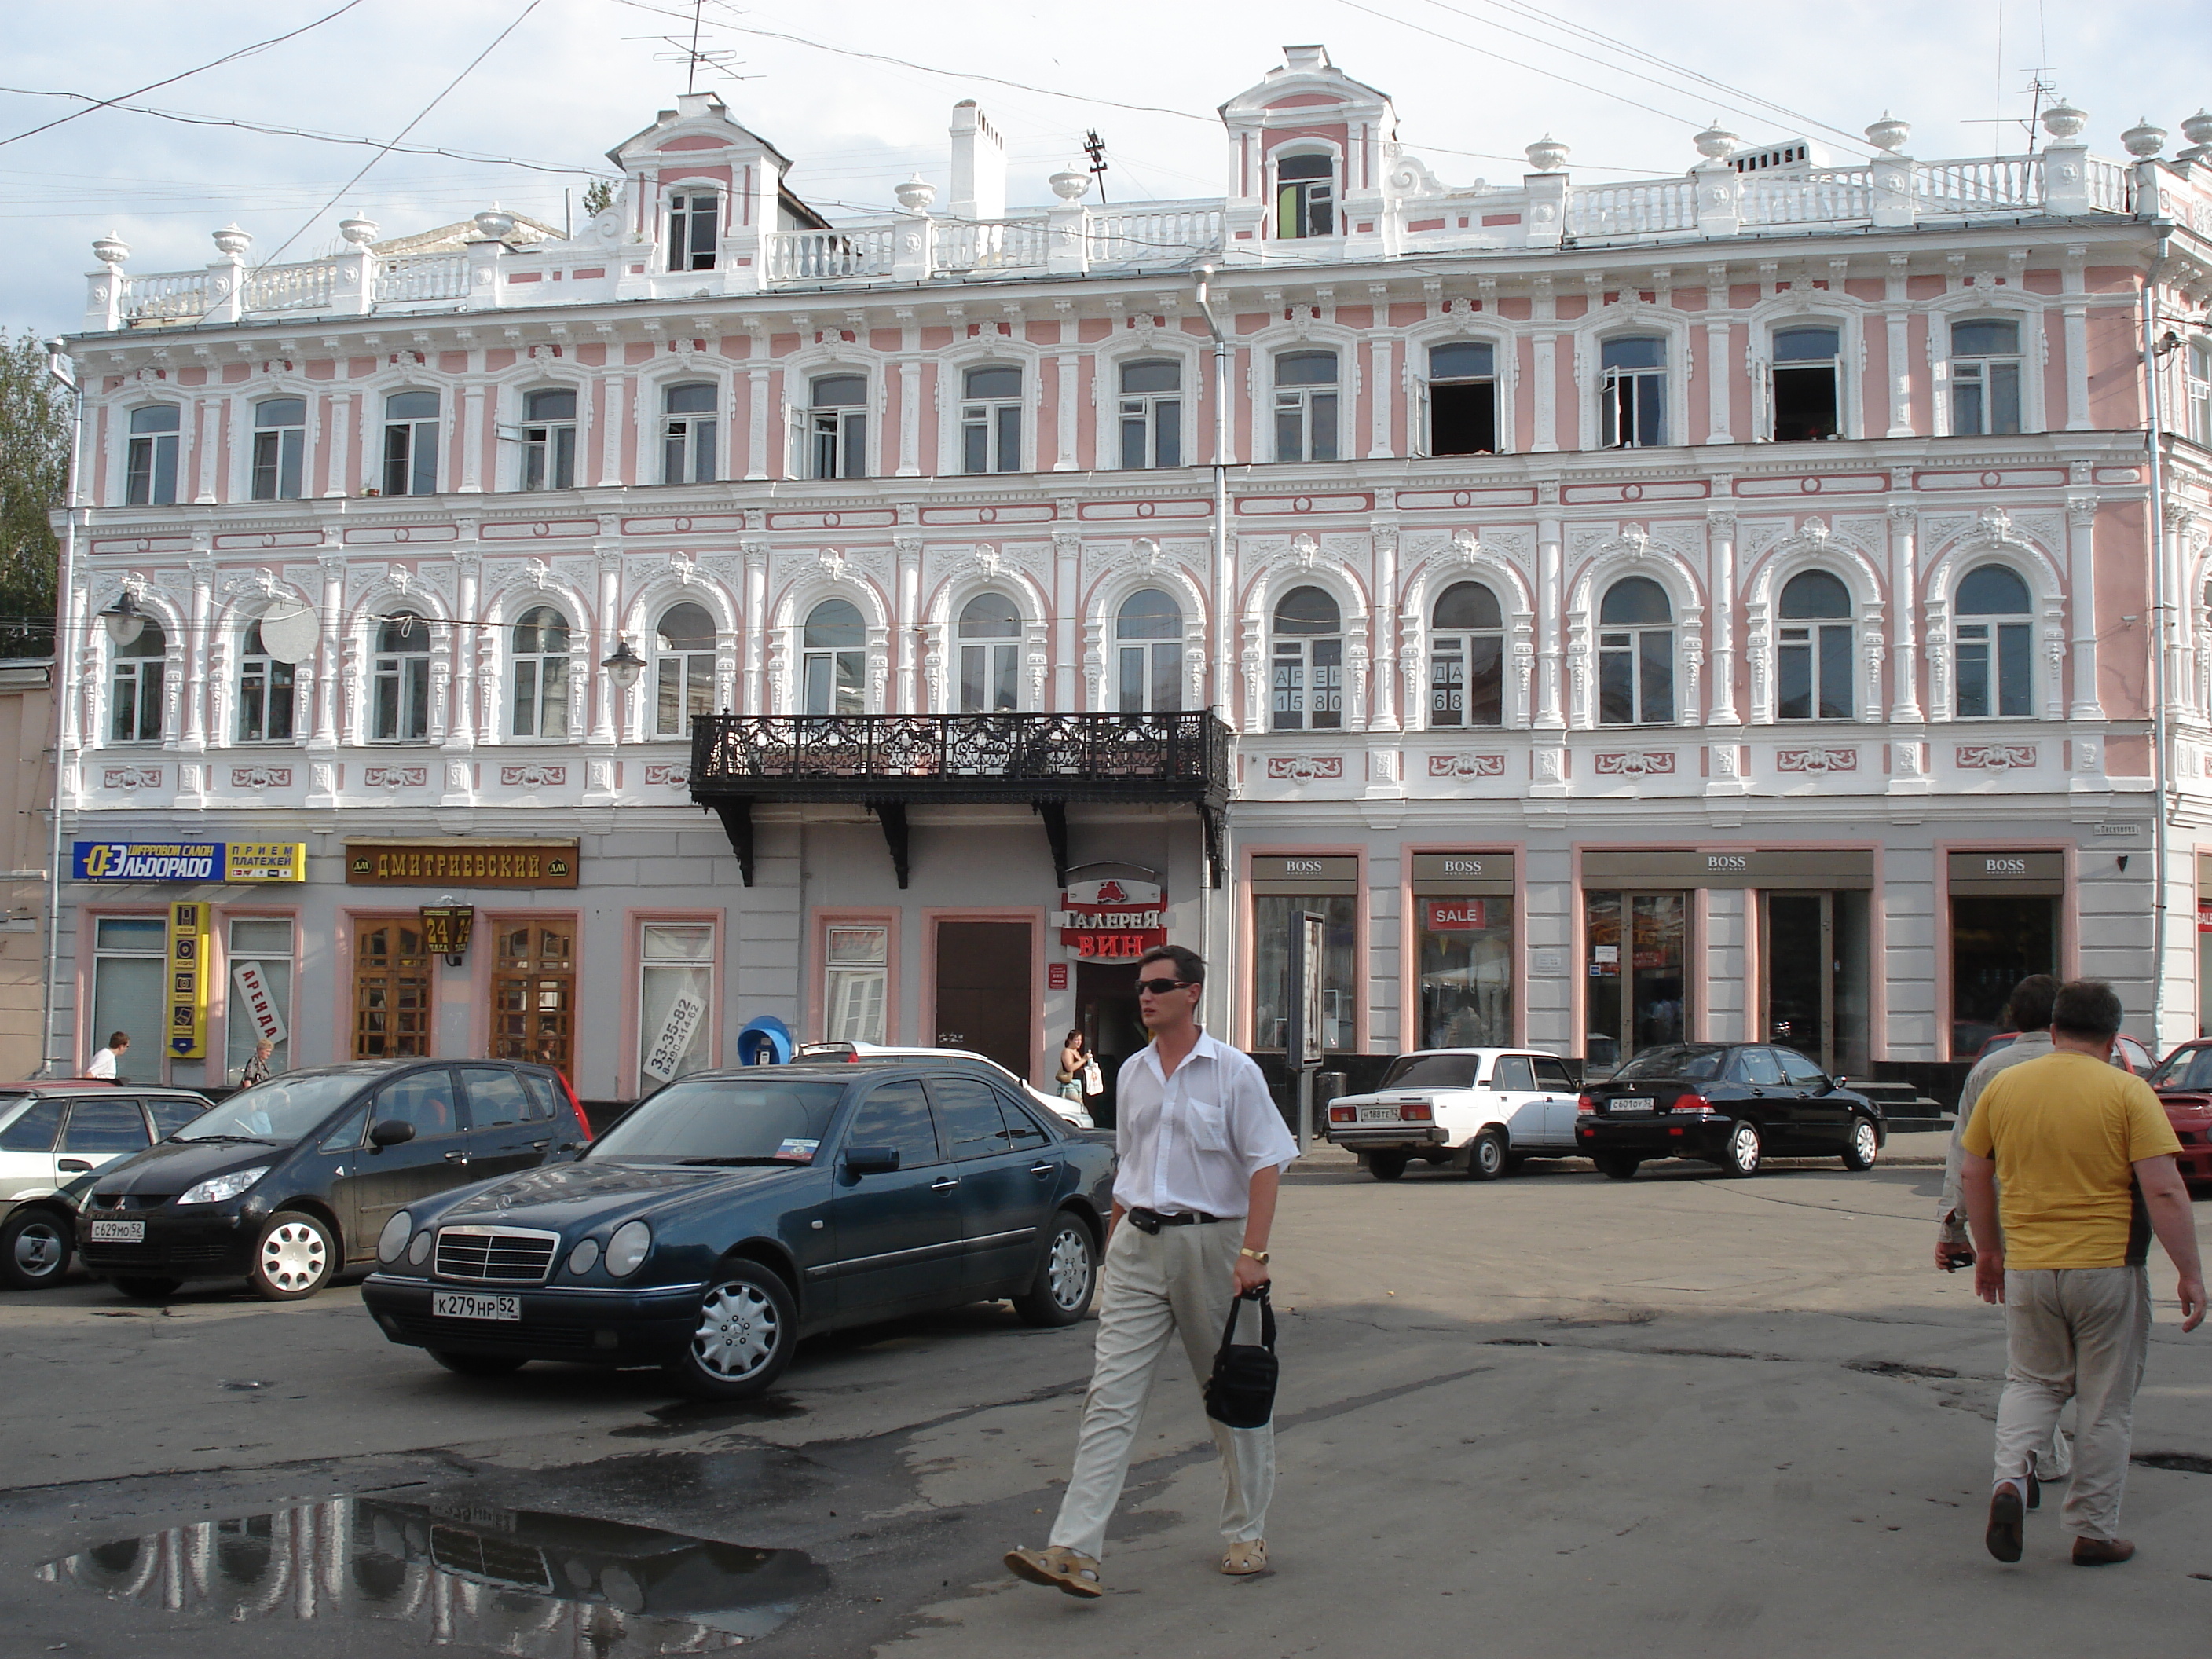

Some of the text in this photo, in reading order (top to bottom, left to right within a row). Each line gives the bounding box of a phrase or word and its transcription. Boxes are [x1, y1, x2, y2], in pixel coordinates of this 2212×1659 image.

[181, 844, 214, 857] САЛОН
[232, 845, 293, 855] ПРИЕМ
[232, 855, 292, 866] ПЛАТЕЖЕЙ
[378, 853, 540, 879] ДМИТРИЕВСКИЙ
[1286, 860, 1322, 872] BOSS
[1445, 860, 1481, 872] BOSS
[1708, 855, 1746, 868] BOSS
[1986, 859, 2025, 871] BOSS
[1063, 909, 1160, 930] ГАЛЕРЕЯ
[1436, 909, 1477, 923] SALE
[426, 917, 449, 943] 24
[1077, 935, 1144, 958] ВИН
[242, 969, 278, 1038] АРЕНДА
[650, 998, 691, 1071] 33-35-82
[661, 1004, 699, 1075] 8-290-414-62
[438, 1295, 515, 1317] К279НР 52
